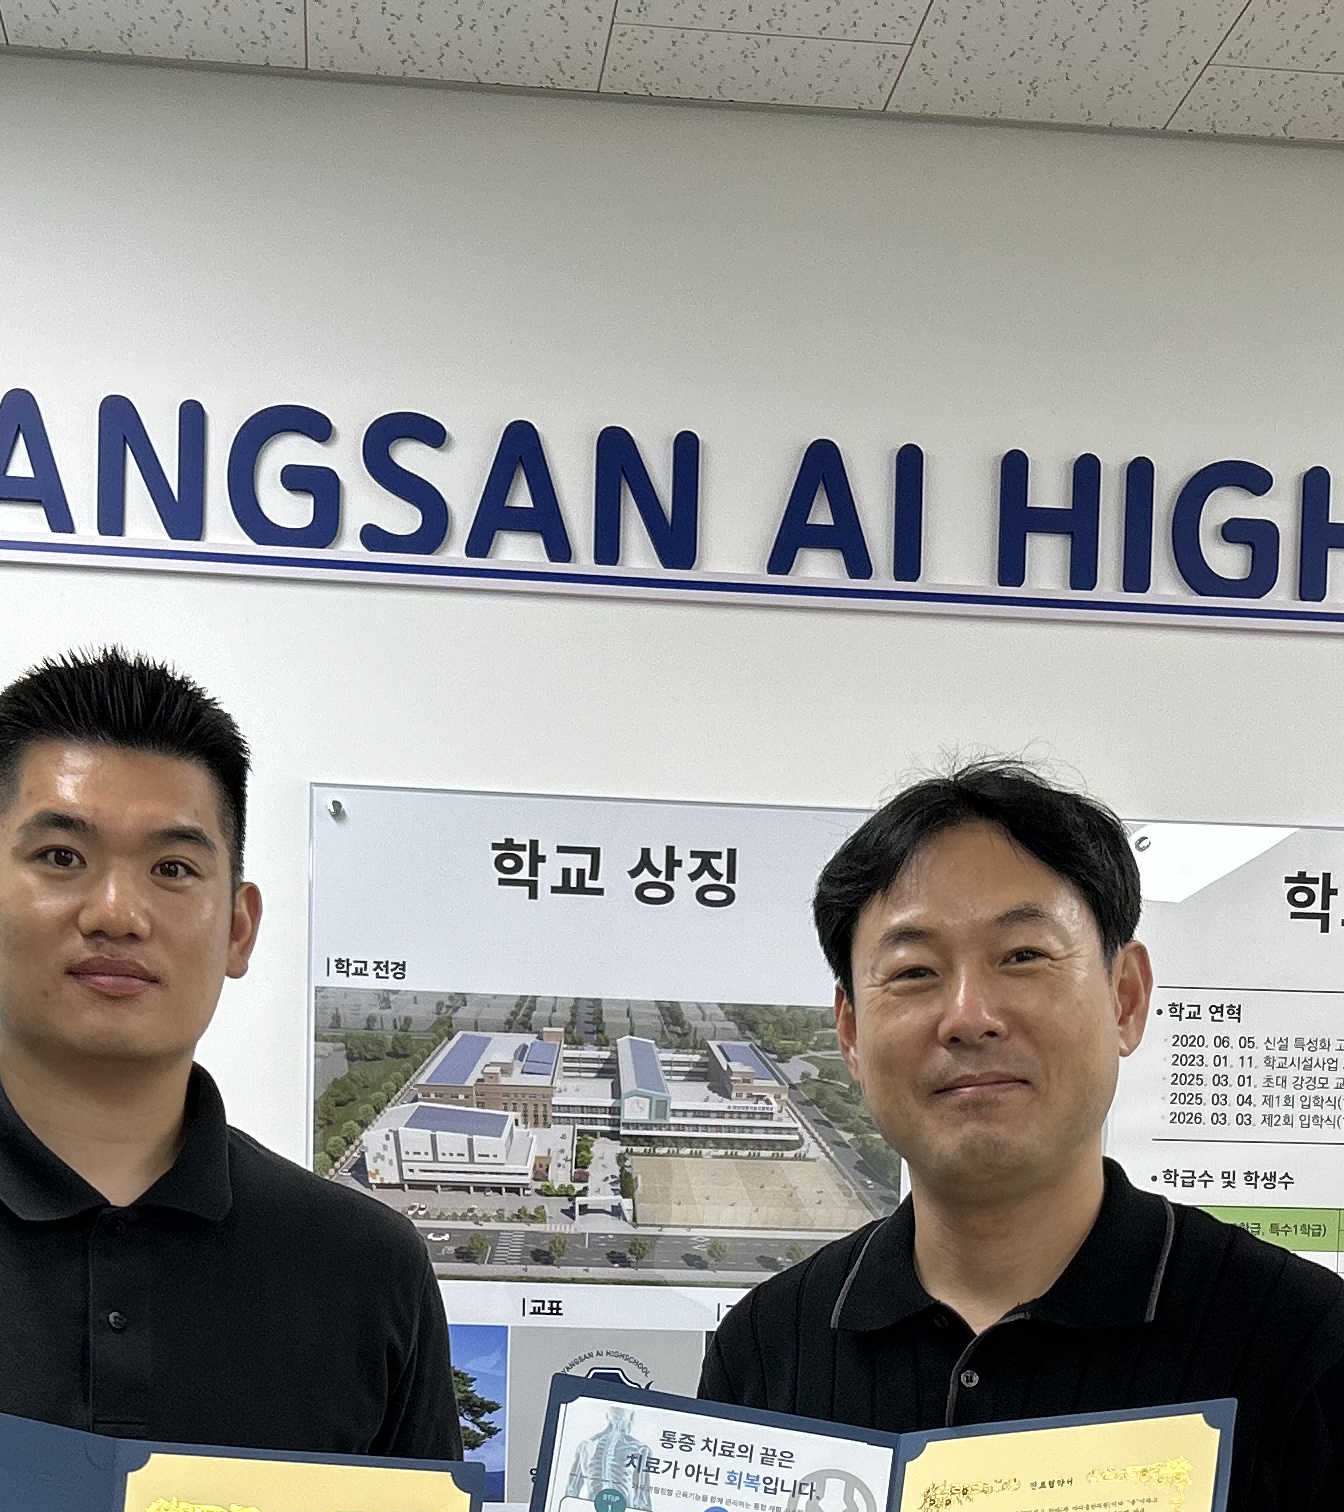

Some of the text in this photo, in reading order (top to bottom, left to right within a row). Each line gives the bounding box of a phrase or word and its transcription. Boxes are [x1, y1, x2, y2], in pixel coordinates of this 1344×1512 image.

[767, 439, 923, 582] AI
[491, 838, 738, 907] 학교 상징
[334, 958, 407, 980] 학교 전경
[1168, 1002, 1242, 1023] 학교 연혁
[1172, 1035, 1208, 1048] 2020.
[1214, 1036, 1233, 1049] 06.
[1239, 1036, 1258, 1049] 05.
[1264, 1037, 1289, 1051] 신설
[1294, 1038, 1331, 1053] 특성화
[1171, 1054, 1208, 1067] 2023.
[1213, 1055, 1233, 1068] 01.
[1239, 1056, 1258, 1068] 11.
[1264, 1056, 1338, 1072] 학교시설사업
[1171, 1073, 1207, 1086] 2025.
[1212, 1074, 1232, 1087] 03.
[1237, 1075, 1257, 1088] 01.
[1262, 1075, 1287, 1089] 초대
[1292, 1076, 1329, 1090] 강경모
[1162, 1169, 1294, 1190] 학급수 및 학생수
[530, 1300, 563, 1315] 교표
[660, 1430, 795, 1469] 통증 치료의 끝은
[625, 1453, 821, 1501] 치료가 아닌 회복입니다.
[608, 1505, 612, 1512] 1
